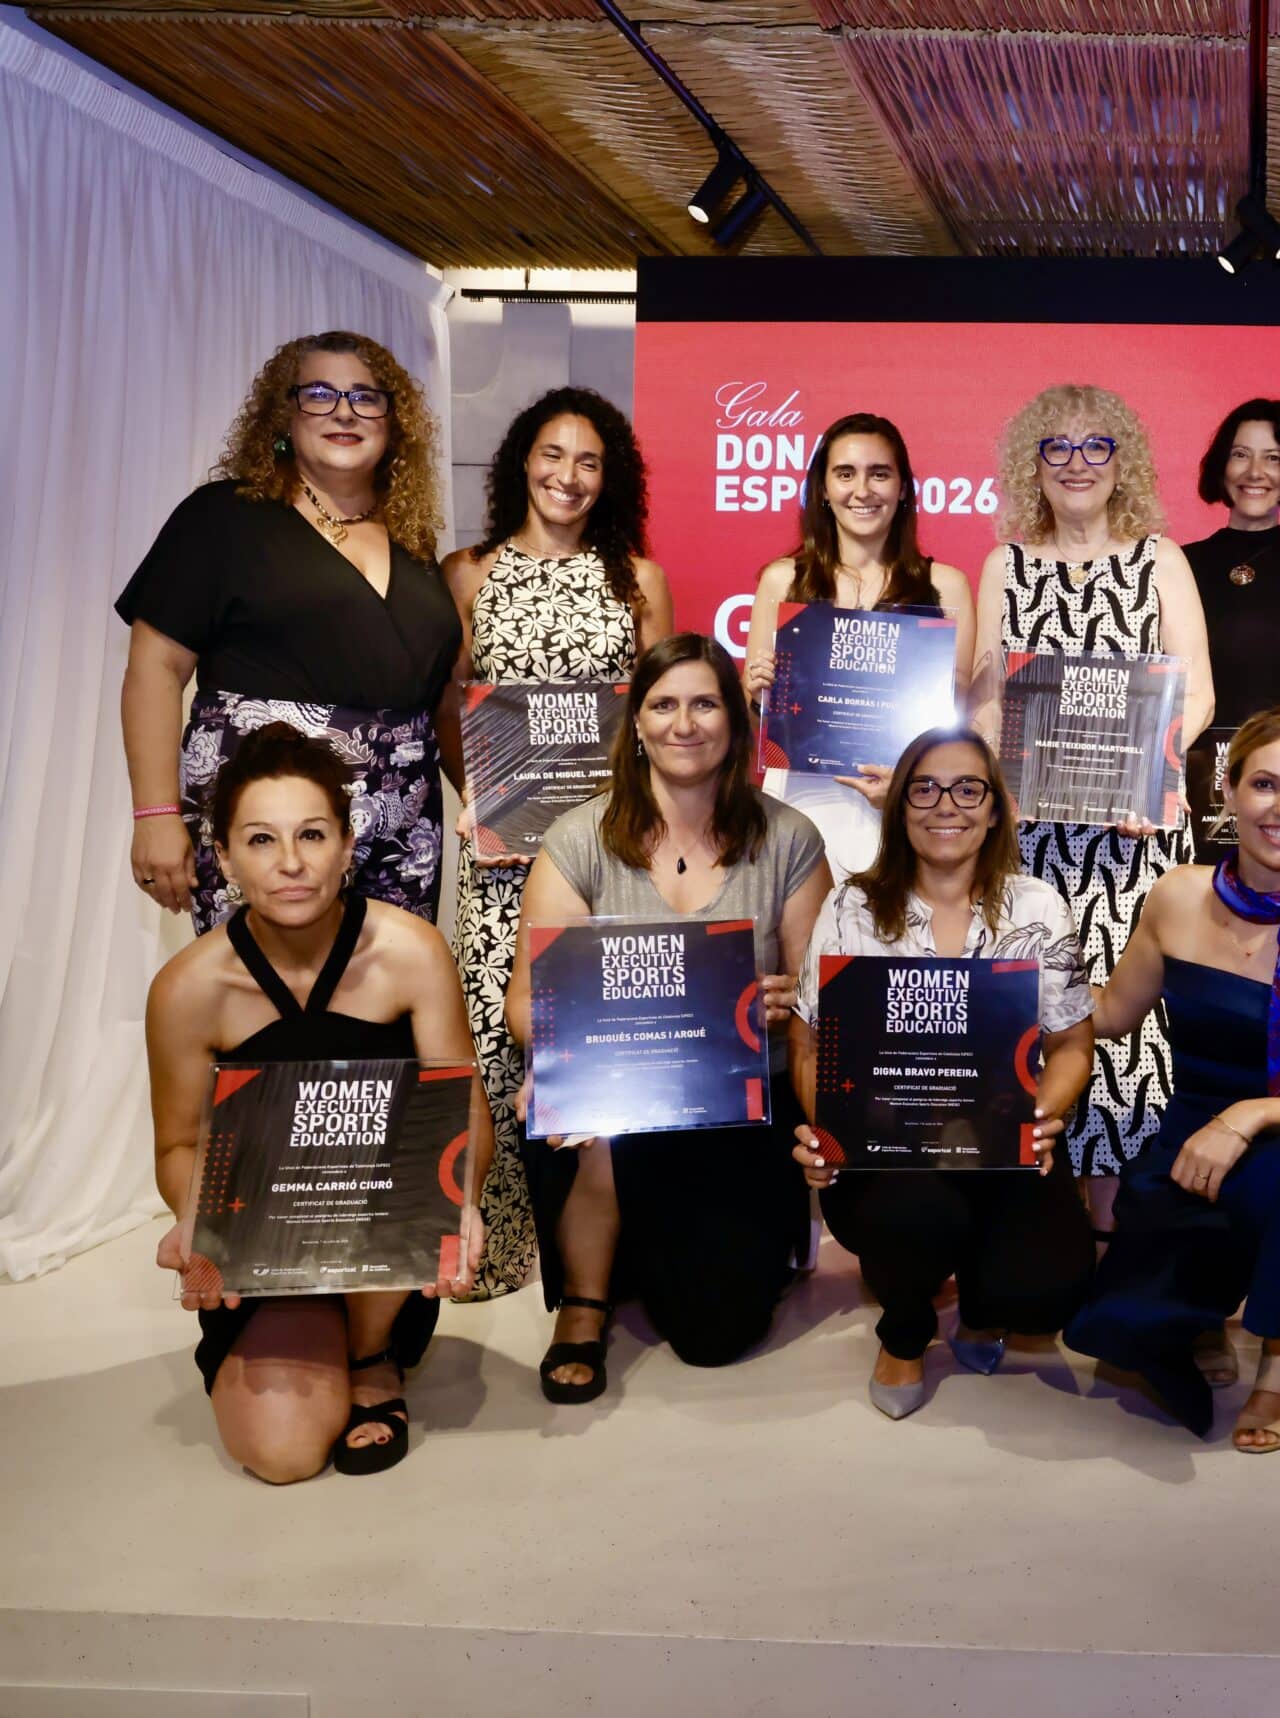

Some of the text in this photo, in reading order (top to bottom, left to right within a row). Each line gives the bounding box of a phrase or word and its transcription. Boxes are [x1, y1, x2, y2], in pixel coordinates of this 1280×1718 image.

[714, 381, 804, 429] Gala
[715, 475, 999, 515] ESP 026
[833, 617, 900, 638] WOMEN
[832, 633, 897, 649] EXECUTIVE
[830, 644, 897, 663] SPORTS
[829, 659, 896, 675] EDUCATION
[1063, 665, 1130, 684] WOMEN
[1061, 680, 1128, 695] EXECUTIVE
[526, 692, 598, 709] WOMEN
[817, 695, 843, 705] CARLA
[1060, 691, 1127, 709] SPORTS
[527, 708, 598, 720] EXECUTIVE
[1059, 705, 1126, 719] EDUCATION
[529, 718, 599, 735] SPORTS
[530, 732, 600, 746] EDUCATION
[1035, 740, 1144, 754] MARIE TEIXIDOR MARTORELL
[513, 771, 541, 781] LAURA
[543, 771, 554, 780] DE
[587, 769, 613, 778] JIMEN
[601, 934, 685, 955] WOMEN
[602, 952, 685, 969] EXECUTIVE
[602, 966, 686, 987] SPORTS
[888, 968, 970, 989] WOMEN
[602, 983, 686, 1001] EDUCATION
[887, 987, 969, 1003] EXECUTIVE
[886, 1002, 968, 1021] SPORTS
[886, 1019, 968, 1034] EDUCATION
[585, 1027, 706, 1044] BRUGUÉS COMAS I ARQUÉ
[872, 1066, 979, 1078] DIGNA BRAVO PEREIRA
[298, 1080, 393, 1100] WOMEN
[294, 1099, 390, 1115] EXECUTIVE
[292, 1112, 388, 1133] SPORTS
[290, 1131, 386, 1147] EDUCATION
[271, 1177, 393, 1192] GEMMA CARRIÓ CIURÓ
